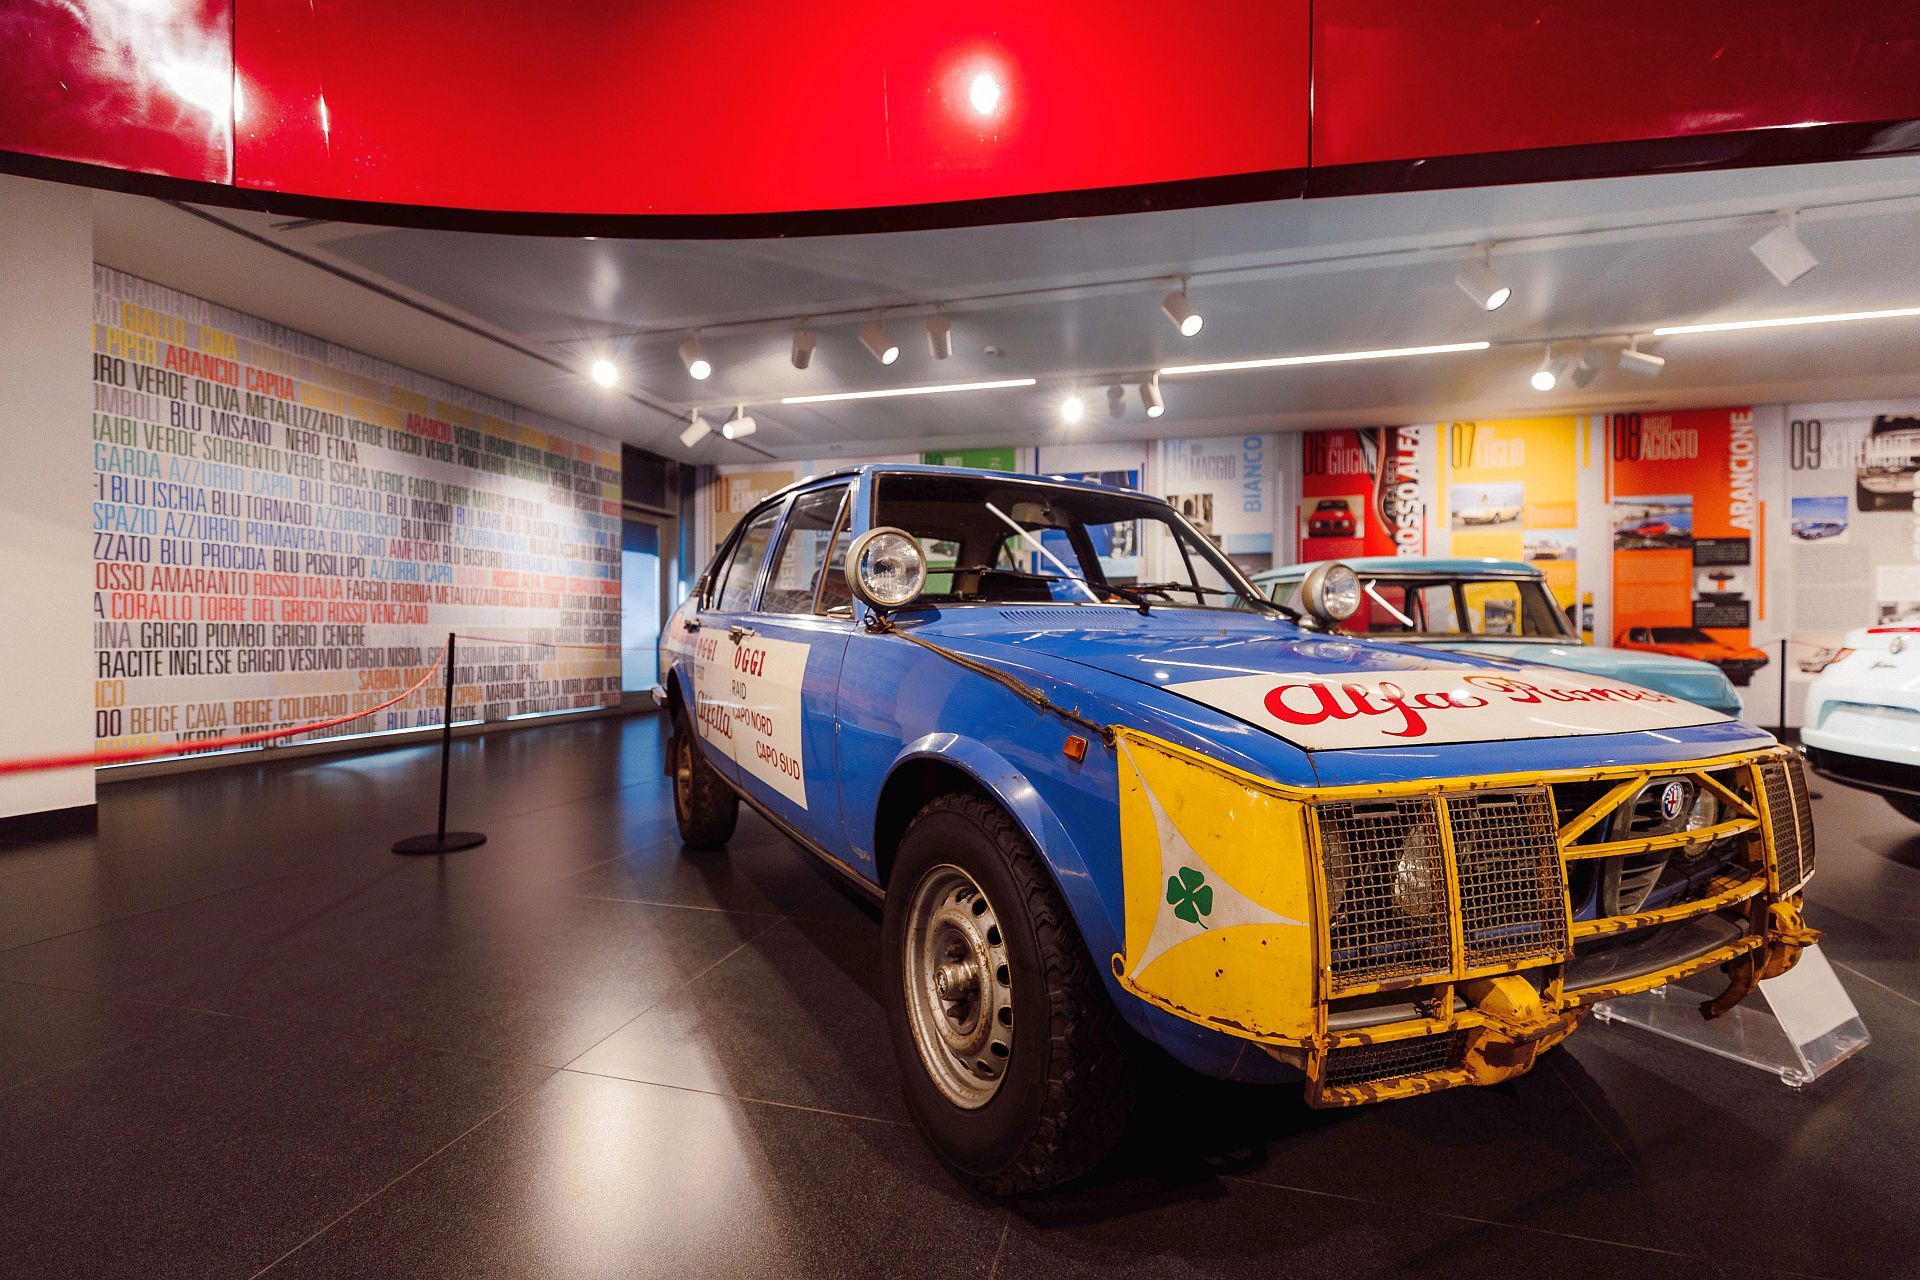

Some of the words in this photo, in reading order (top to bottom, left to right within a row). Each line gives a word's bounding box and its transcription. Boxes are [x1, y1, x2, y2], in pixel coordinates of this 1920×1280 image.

[121, 301, 186, 347] GIALLO
[106, 326, 158, 368] PIPER
[165, 343, 239, 389] ARANCIO
[246, 366, 295, 401] CAPUA
[406, 411, 451, 442] ARANCIO
[133, 363, 189, 402] VERDE
[196, 379, 241, 413] OLIVA
[246, 392, 344, 439] METALLIZZATO
[348, 417, 383, 447] VERDE
[424, 438, 454, 464] VERDE
[170, 401, 201, 431] BLU
[211, 410, 272, 446] MISANO
[286, 427, 321, 457] NERO
[327, 437, 359, 464] ETNA
[1613, 412, 1641, 462] 08
[144, 423, 198, 458] VERDE
[203, 435, 281, 473] SORRENTO
[285, 451, 325, 481] VERDE
[330, 462, 368, 488] ISCHIA
[371, 470, 404, 495] VERDE
[442, 483, 469, 506] VERDE
[1190, 454, 1236, 481] MAGGIO
[1396, 424, 1420, 481] ALFA
[1451, 422, 1477, 469] 07
[1640, 428, 1699, 461] AGOSTO
[1791, 418, 1822, 471] 09
[94, 443, 161, 481] GARDA
[169, 456, 244, 492] AZZURRO
[252, 470, 294, 498] CAPRI
[300, 479, 323, 504] BLU
[329, 484, 382, 514] COBALTO
[387, 494, 407, 517] BLU
[411, 499, 453, 524] INVERNO
[457, 505, 473, 527] BLU
[1243, 434, 1263, 513] BIANCO
[1728, 411, 1755, 531] ARANCIONE
[111, 475, 146, 506] BLU
[152, 481, 207, 513] ISCHIA
[212, 490, 241, 518] BLU
[246, 495, 312, 527] TORNADO
[315, 506, 371, 534] AZZURRO
[375, 514, 397, 538] ISEO
[401, 518, 420, 541] BLU
[423, 522, 452, 543] NOTTE
[1396, 482, 1420, 557] ROSSO
[93, 502, 158, 536] SPAZIO
[164, 511, 240, 544] AZZURRO
[246, 521, 326, 552] PRIMAVERA
[330, 531, 353, 555] BLU
[357, 535, 386, 558] SIRIO
[389, 539, 440, 563] AMETISTA
[443, 545, 460, 566] BLU
[463, 547, 502, 569] BOSFORO
[93, 532, 151, 564] ZZATO
[160, 538, 192, 567] BLU
[201, 542, 267, 572] PROCIDA
[273, 549, 299, 574] BLU
[306, 553, 365, 578] POSILLIPO
[370, 558, 419, 583] AZZURRO
[424, 563, 452, 584] CAPRI
[94, 591, 105, 619] A
[111, 592, 192, 621] CORALLO
[199, 596, 247, 623] TORRE
[252, 598, 274, 622] DEL
[281, 600, 323, 623] GRECO
[327, 602, 369, 624] ROSSO
[370, 603, 429, 625] VENEZIANO
[96, 562, 145, 592] OSSO
[151, 566, 248, 595] AMARANTO
[253, 573, 299, 598] ROSSO
[303, 576, 343, 600] ITALIA
[347, 579, 387, 602] FAGGIO
[391, 583, 431, 604] ROBINIA
[435, 586, 499, 606] METALLIZZATO
[141, 622, 198, 649] GRIGIO
[206, 623, 265, 648] PIOMBO
[273, 624, 317, 648] GRIGIO
[323, 624, 365, 647] CENERE
[95, 650, 163, 678] RACITE
[169, 650, 232, 676] INGLESE
[237, 649, 285, 674] GRIGIO
[288, 648, 342, 672] VESUVIO
[346, 648, 384, 671] GRIGIO
[387, 647, 422, 668] NISIDA
[358, 669, 400, 692] SABBIA
[477, 664, 513, 684] ATOMICO
[734, 645, 767, 678] OGGI
[96, 709, 122, 738] DO
[130, 704, 179, 735] BEIGE
[185, 702, 229, 730] CAVA
[233, 699, 273, 726] BEIGE
[278, 694, 348, 721] COLORADO
[486, 681, 526, 703] MARRONE
[529, 680, 550, 699] TESTA
[731, 679, 747, 701] RAID
[1263, 681, 1488, 738] Alfa
[1462, 674, 1679, 706] Romeo
[387, 711, 409, 731] BLU
[416, 708, 442, 728] ALFA
[732, 706, 751, 727] CAPO
[751, 710, 773, 737] NORD
[756, 740, 778, 768] CAPO
[779, 752, 801, 780] SUD
